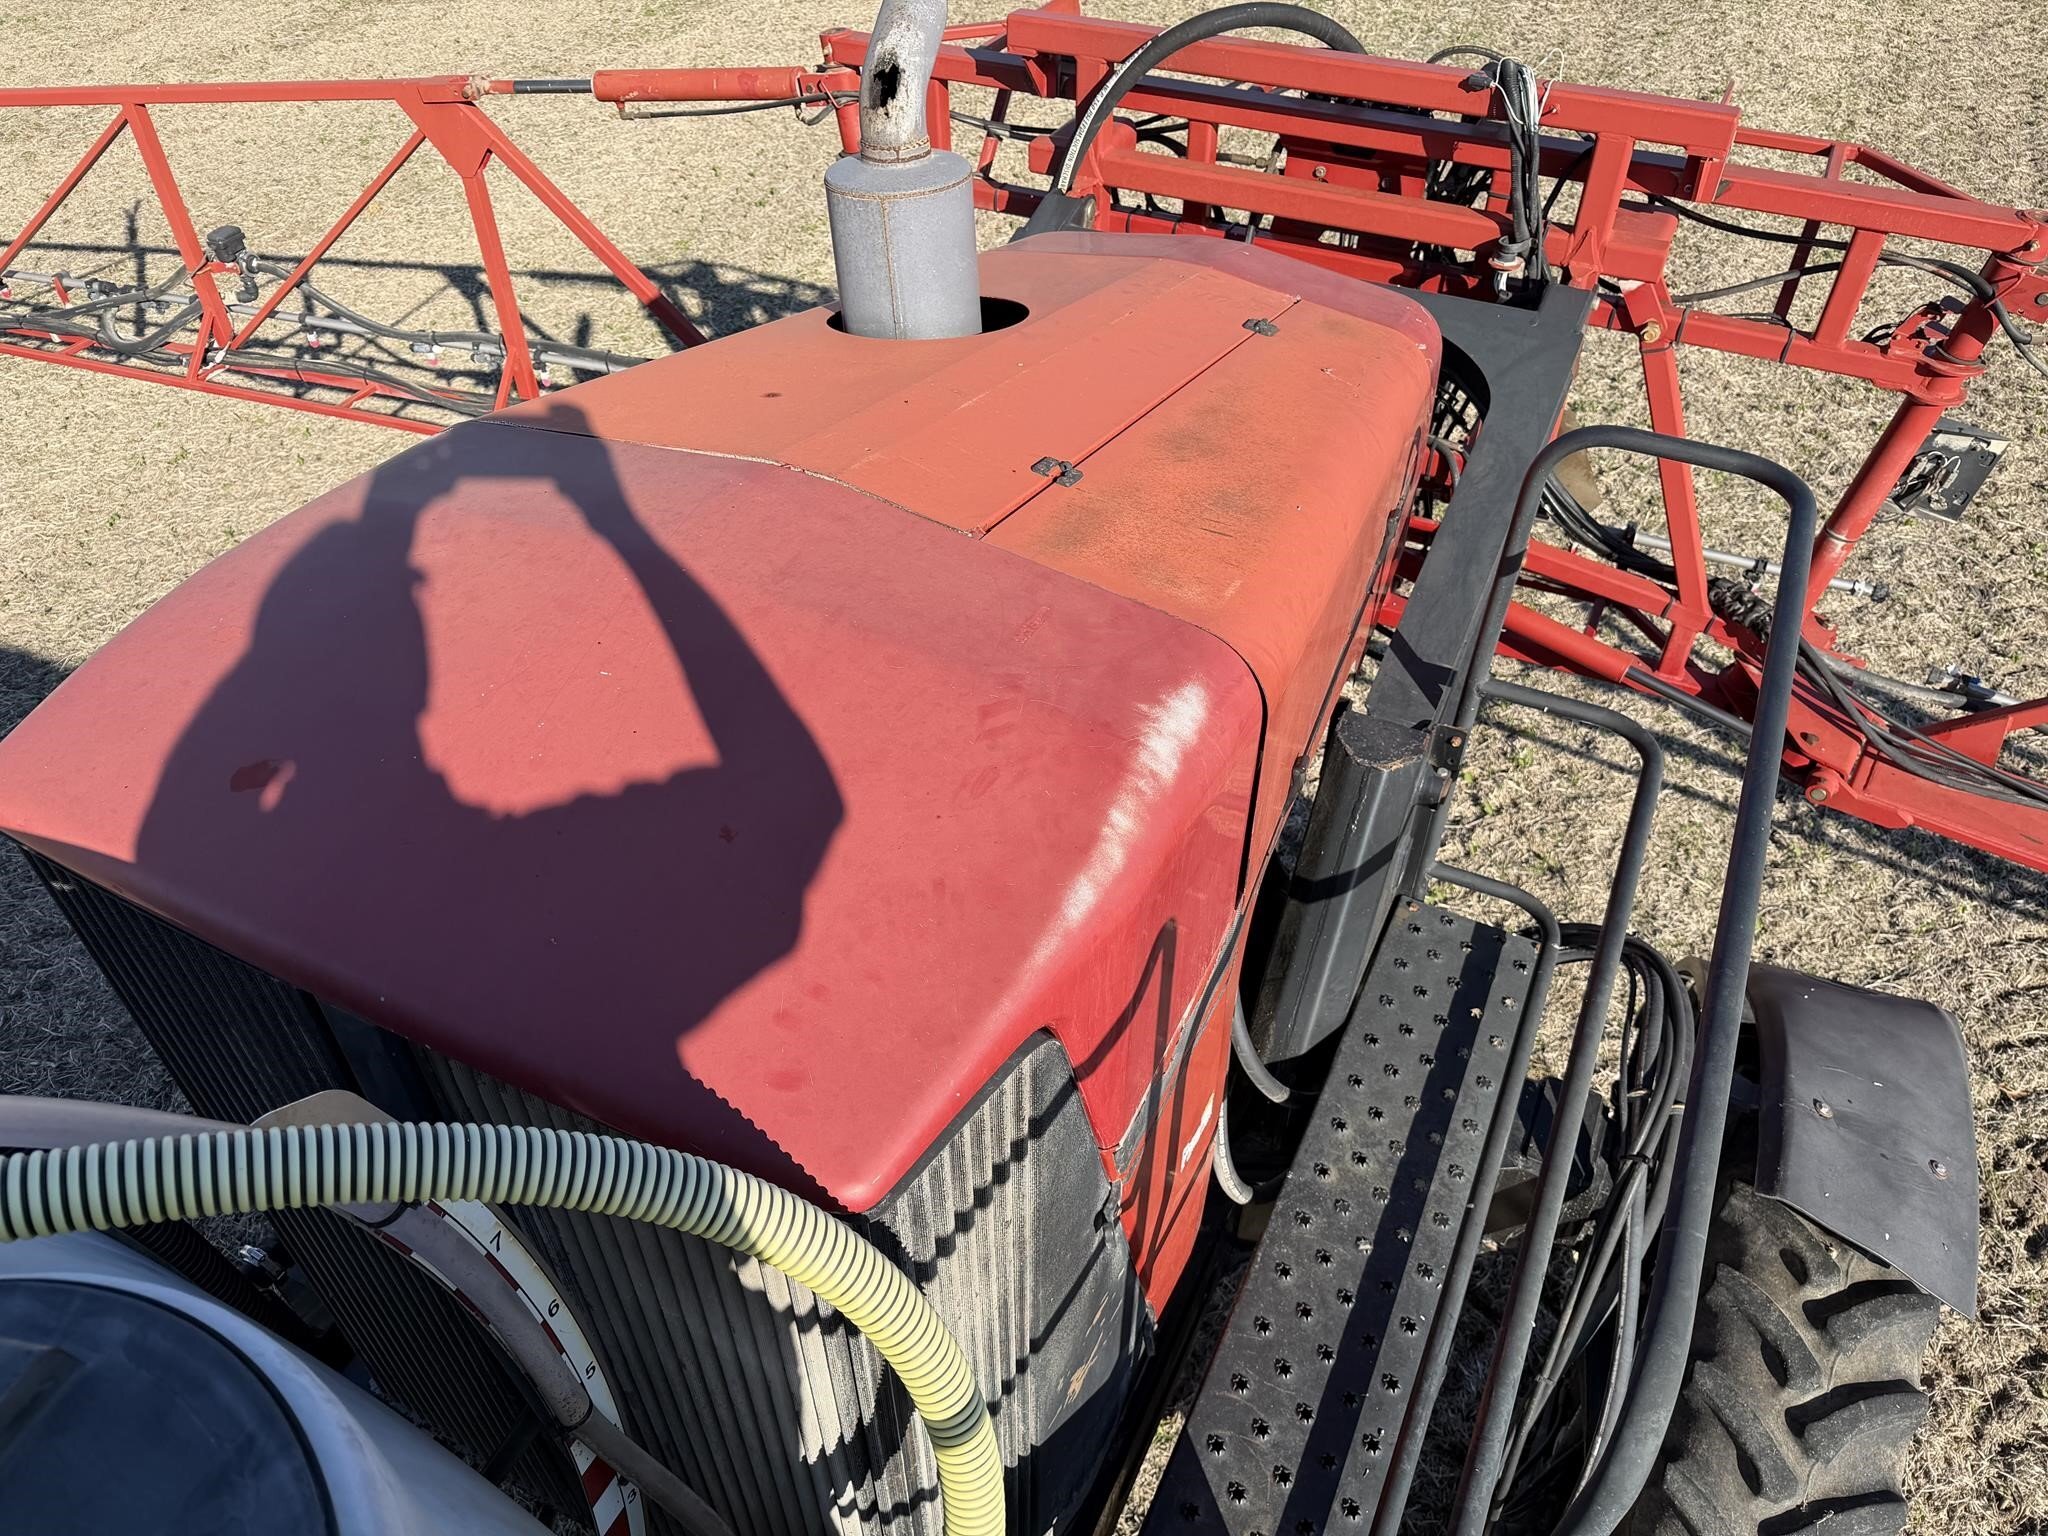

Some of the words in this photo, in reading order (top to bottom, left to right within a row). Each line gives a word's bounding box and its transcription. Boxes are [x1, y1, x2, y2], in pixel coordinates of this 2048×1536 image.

[1067, 137, 1081, 163] SUCTION
[1059, 162, 1072, 189] DISCHAR
[489, 1230, 502, 1252] 7
[547, 1299, 560, 1318] 6
[585, 1361, 597, 1380] 5
[627, 1487, 637, 1505] 3
